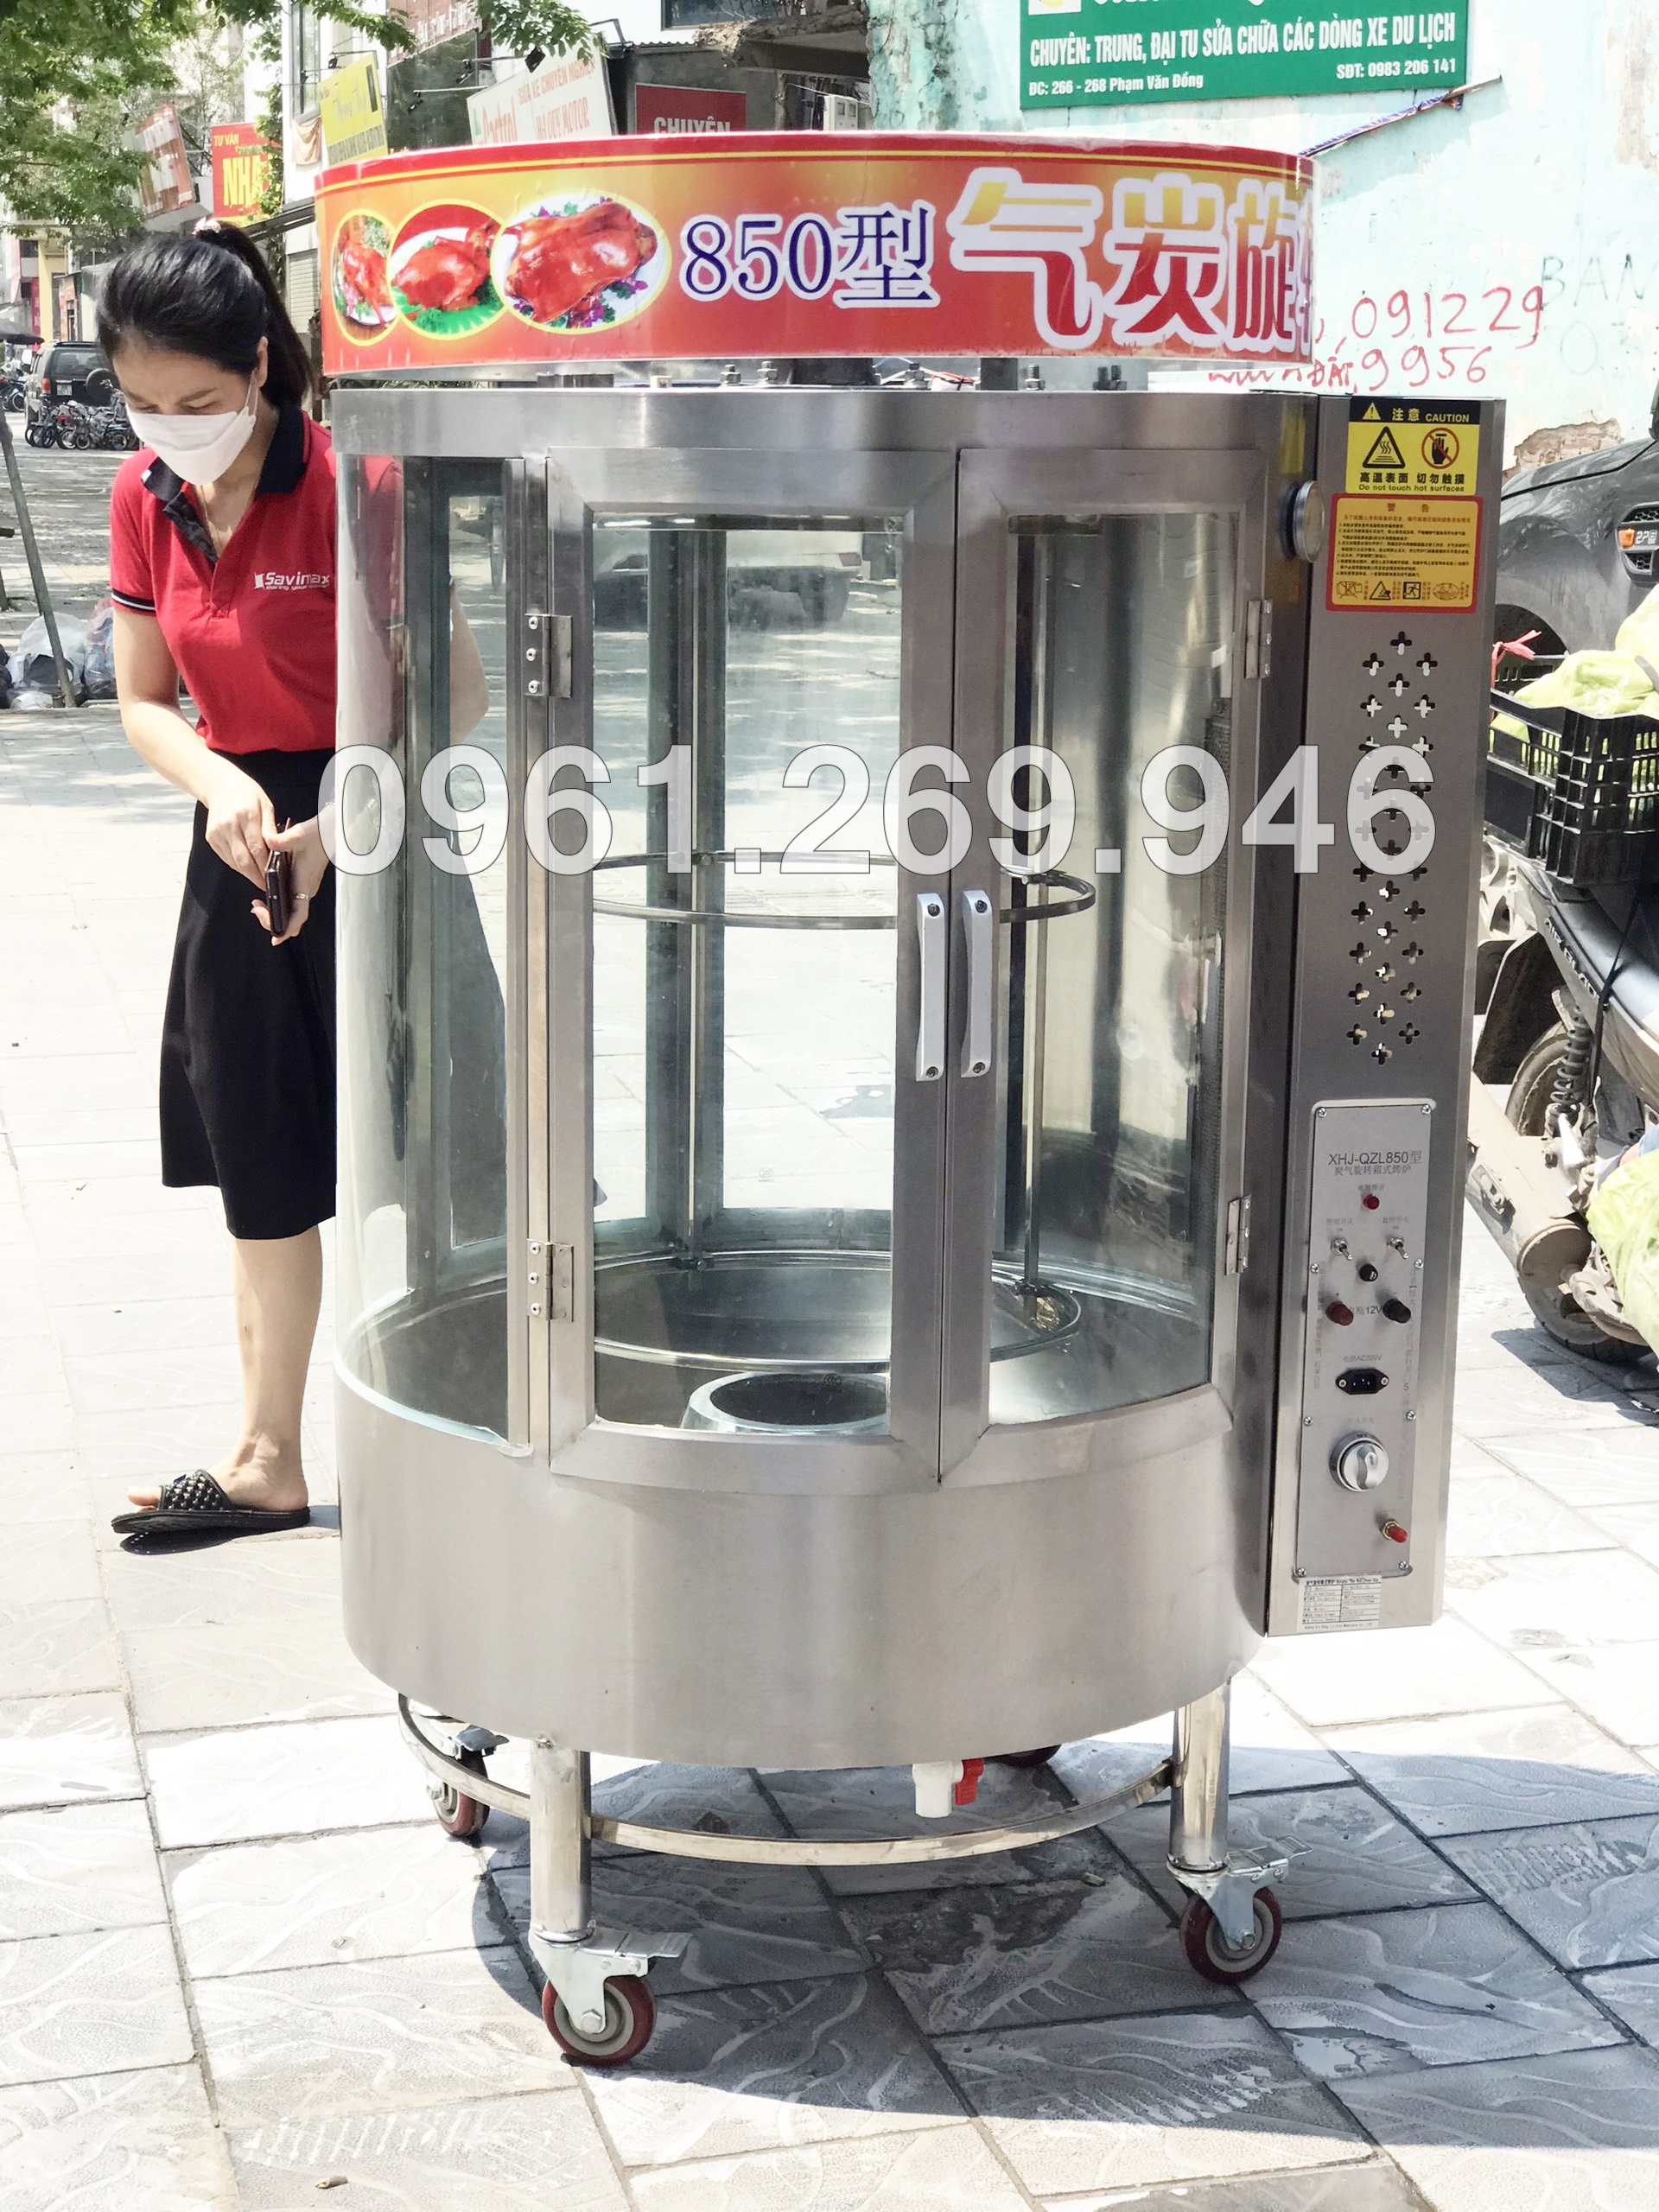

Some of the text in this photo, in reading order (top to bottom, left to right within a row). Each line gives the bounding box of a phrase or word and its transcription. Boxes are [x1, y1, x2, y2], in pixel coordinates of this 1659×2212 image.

[1030, 12, 1456, 67] CHUYÊN: TRUNG, ĐẠI TU SỬA CHỮA CÁC DÒNG XE DU LỊCH
[1029, 81, 1049, 96] ĐC:
[1052, 80, 1073, 95] 266
[1084, 79, 1107, 93] 268
[1109, 76, 1143, 93] Phạm
[1147, 74, 1169, 90] Văn
[1172, 71, 1204, 89] Đồng
[1337, 58, 1456, 79] SĐT: 0983 206 141
[680, 206, 938, 308] 850型
[1351, 285, 1543, 349] 091229
[1361, 346, 1492, 391] 9956
[1392, 408, 1469, 423] 注意 CAUTION
[1328, 1150, 1422, 1166] XHJ-QZL850型
